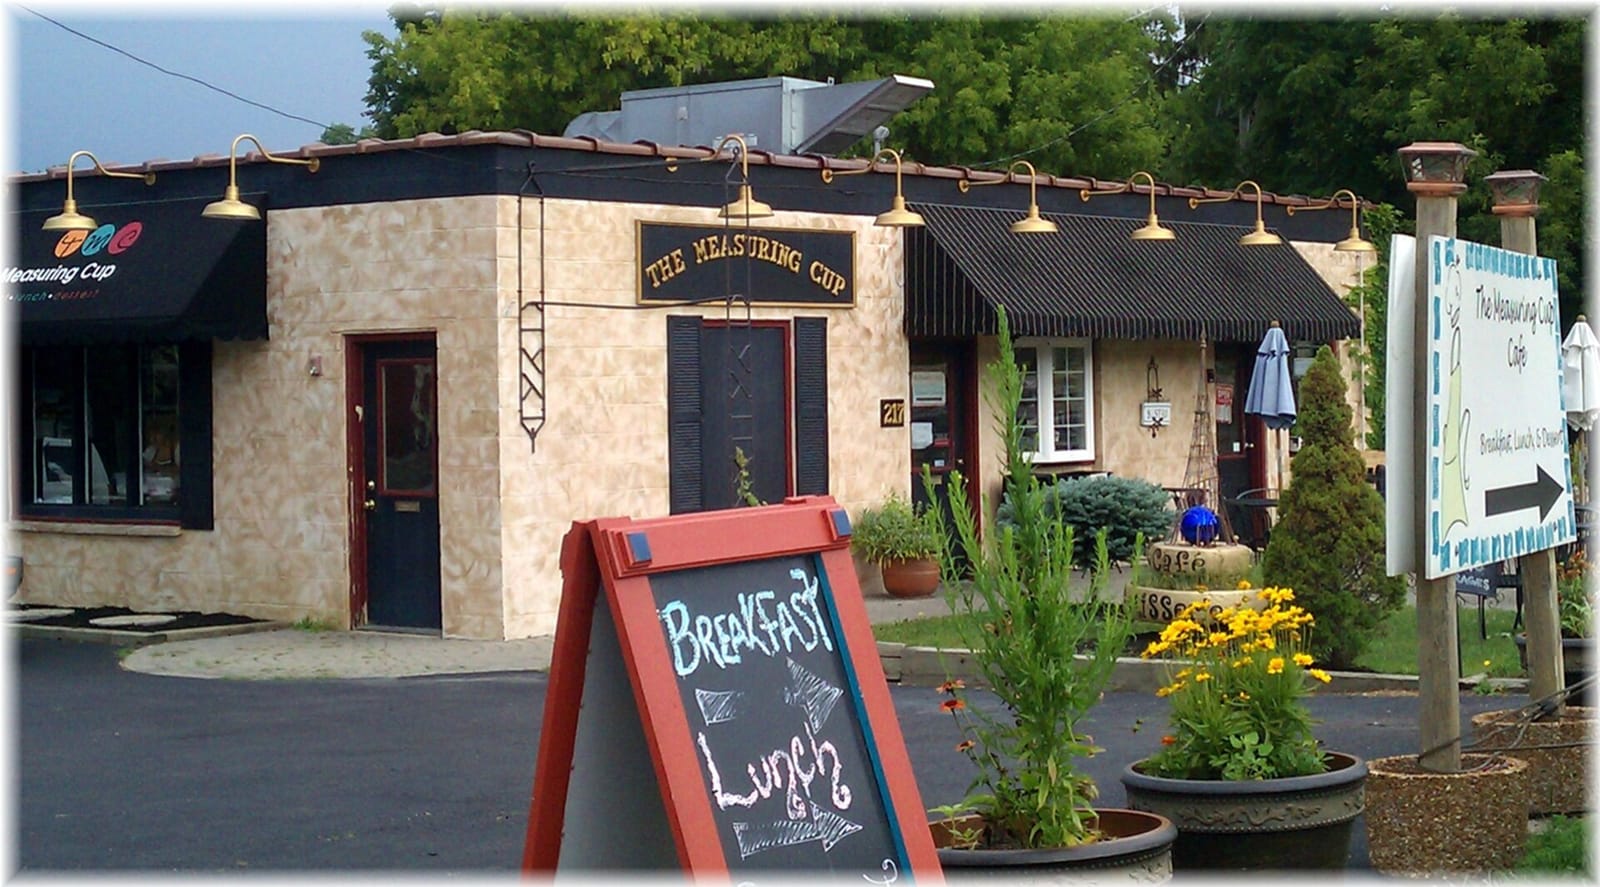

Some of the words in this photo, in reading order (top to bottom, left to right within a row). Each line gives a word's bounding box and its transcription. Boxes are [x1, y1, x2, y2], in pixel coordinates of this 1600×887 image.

[80, 262, 117, 282] Cup
[645, 248, 687, 289] THE
[692, 233, 803, 274] MEASURING
[809, 260, 847, 296] CUP
[1476, 284, 1493, 319] The
[1493, 287, 1537, 335] Measuring
[1538, 296, 1554, 336] Cup
[1507, 334, 1528, 374] Cafe
[884, 403, 904, 424] 217
[1152, 548, 1206, 573] Café
[657, 568, 834, 679] BREAKFAST
[698, 720, 852, 820] Lunch
